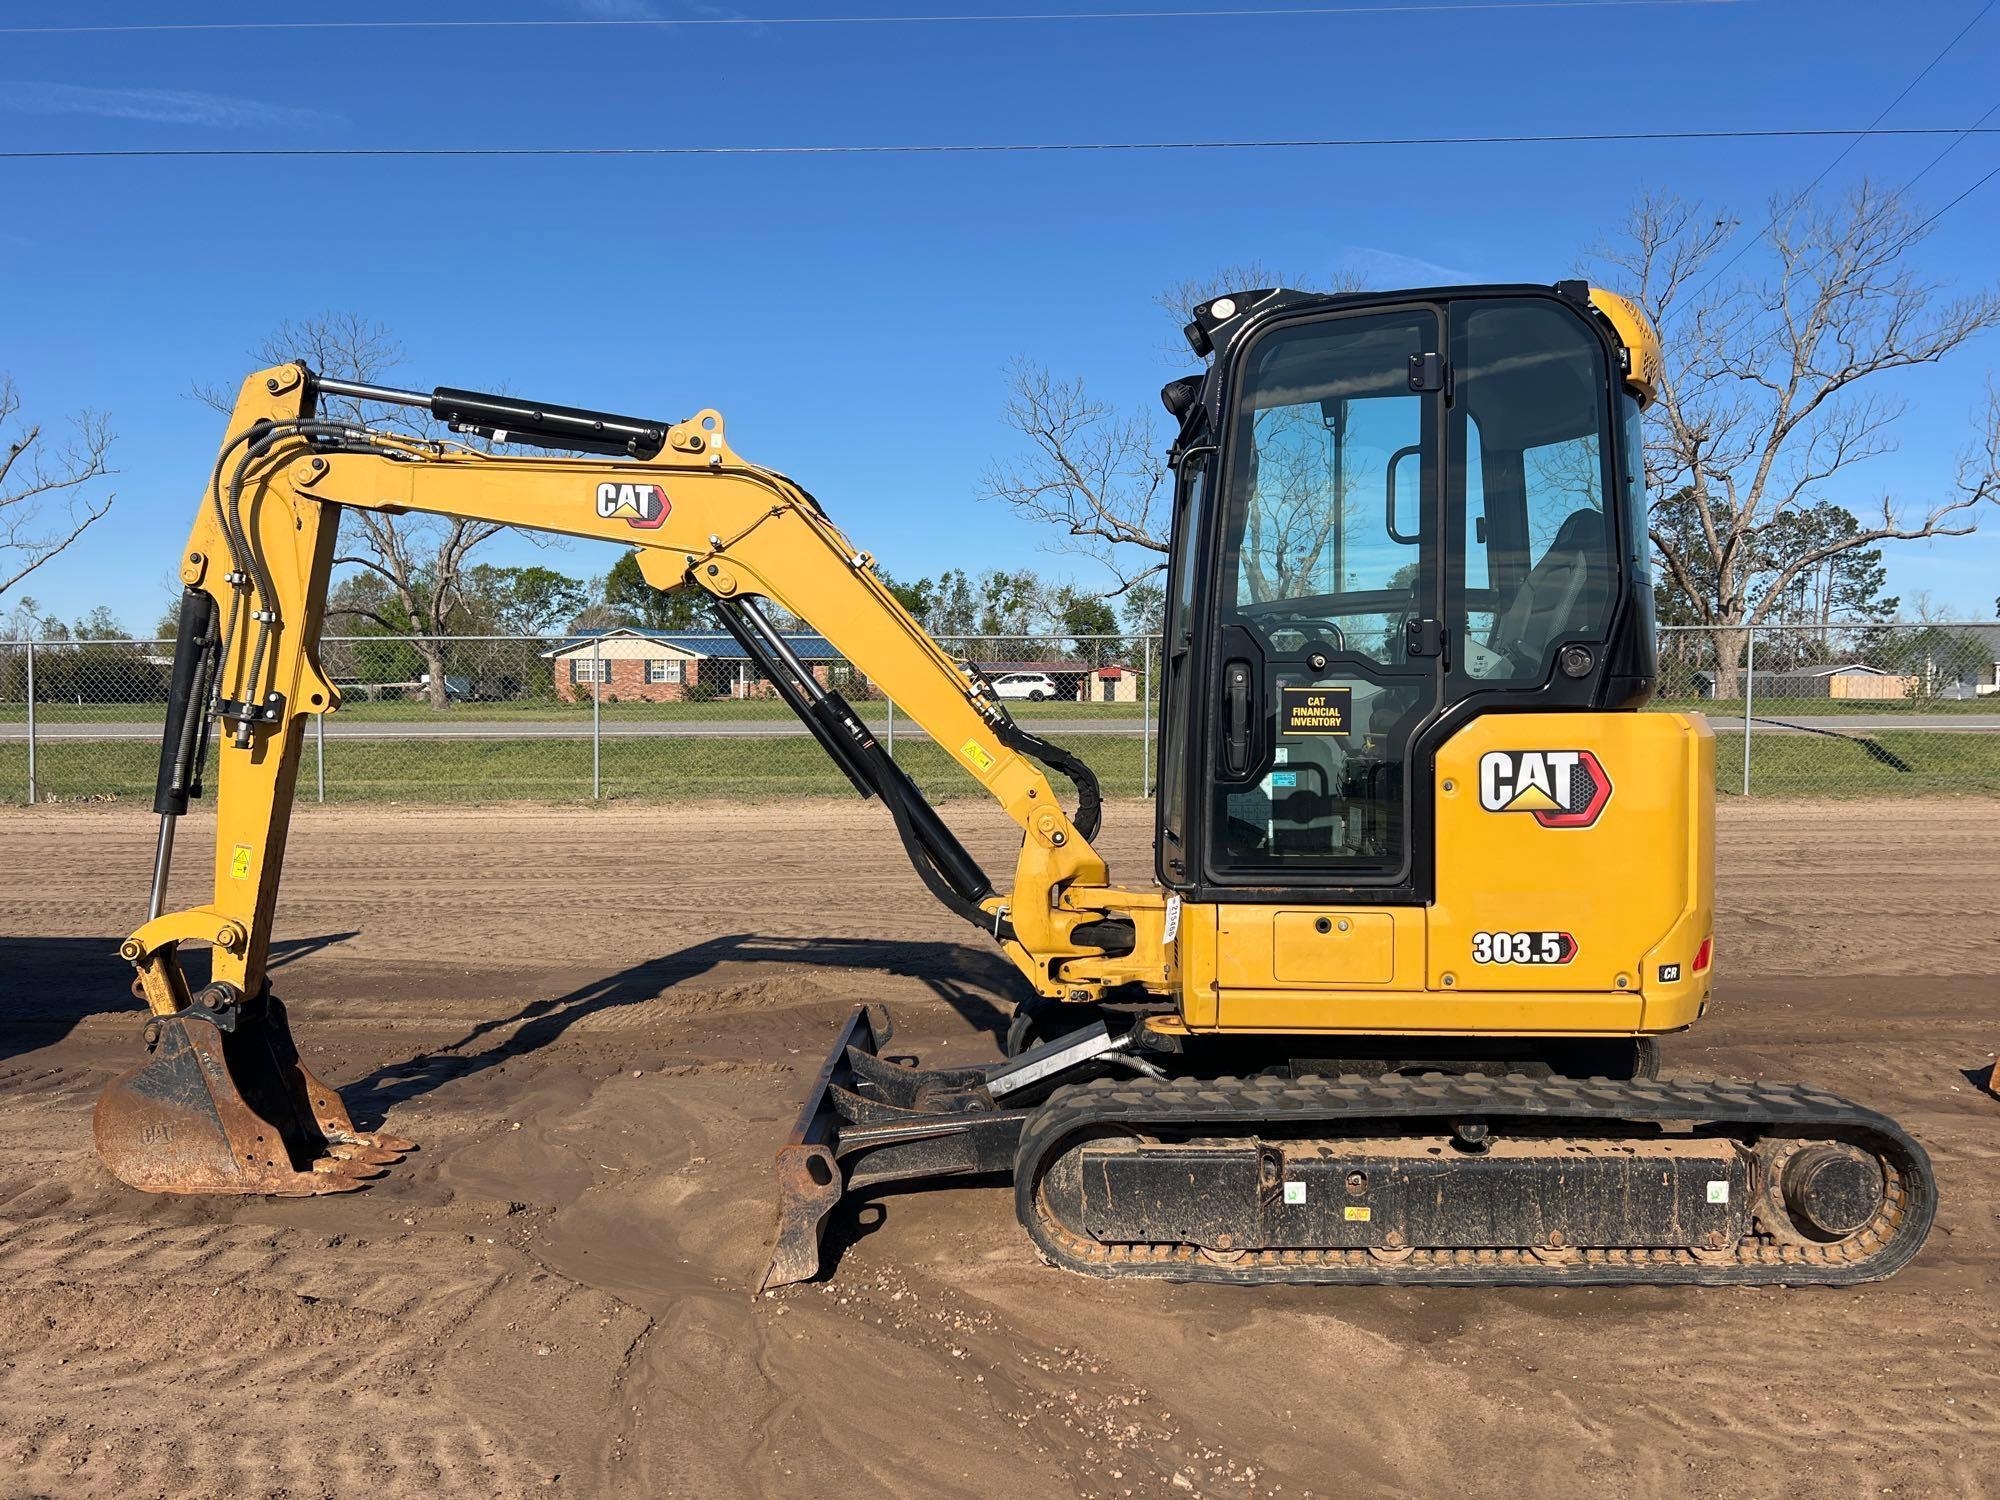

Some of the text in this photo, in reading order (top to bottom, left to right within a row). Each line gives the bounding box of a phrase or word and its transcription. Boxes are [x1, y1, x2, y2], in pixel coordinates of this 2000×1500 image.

[597, 483, 653, 518] CAT
[1307, 697, 1326, 706] CAT
[1292, 707, 1341, 717] FINANCIAL
[1290, 717, 1342, 727] INVENTORY
[1480, 751, 1579, 810] CAT
[1473, 932, 1560, 963] 303.5
[1663, 966, 1678, 980] CR
